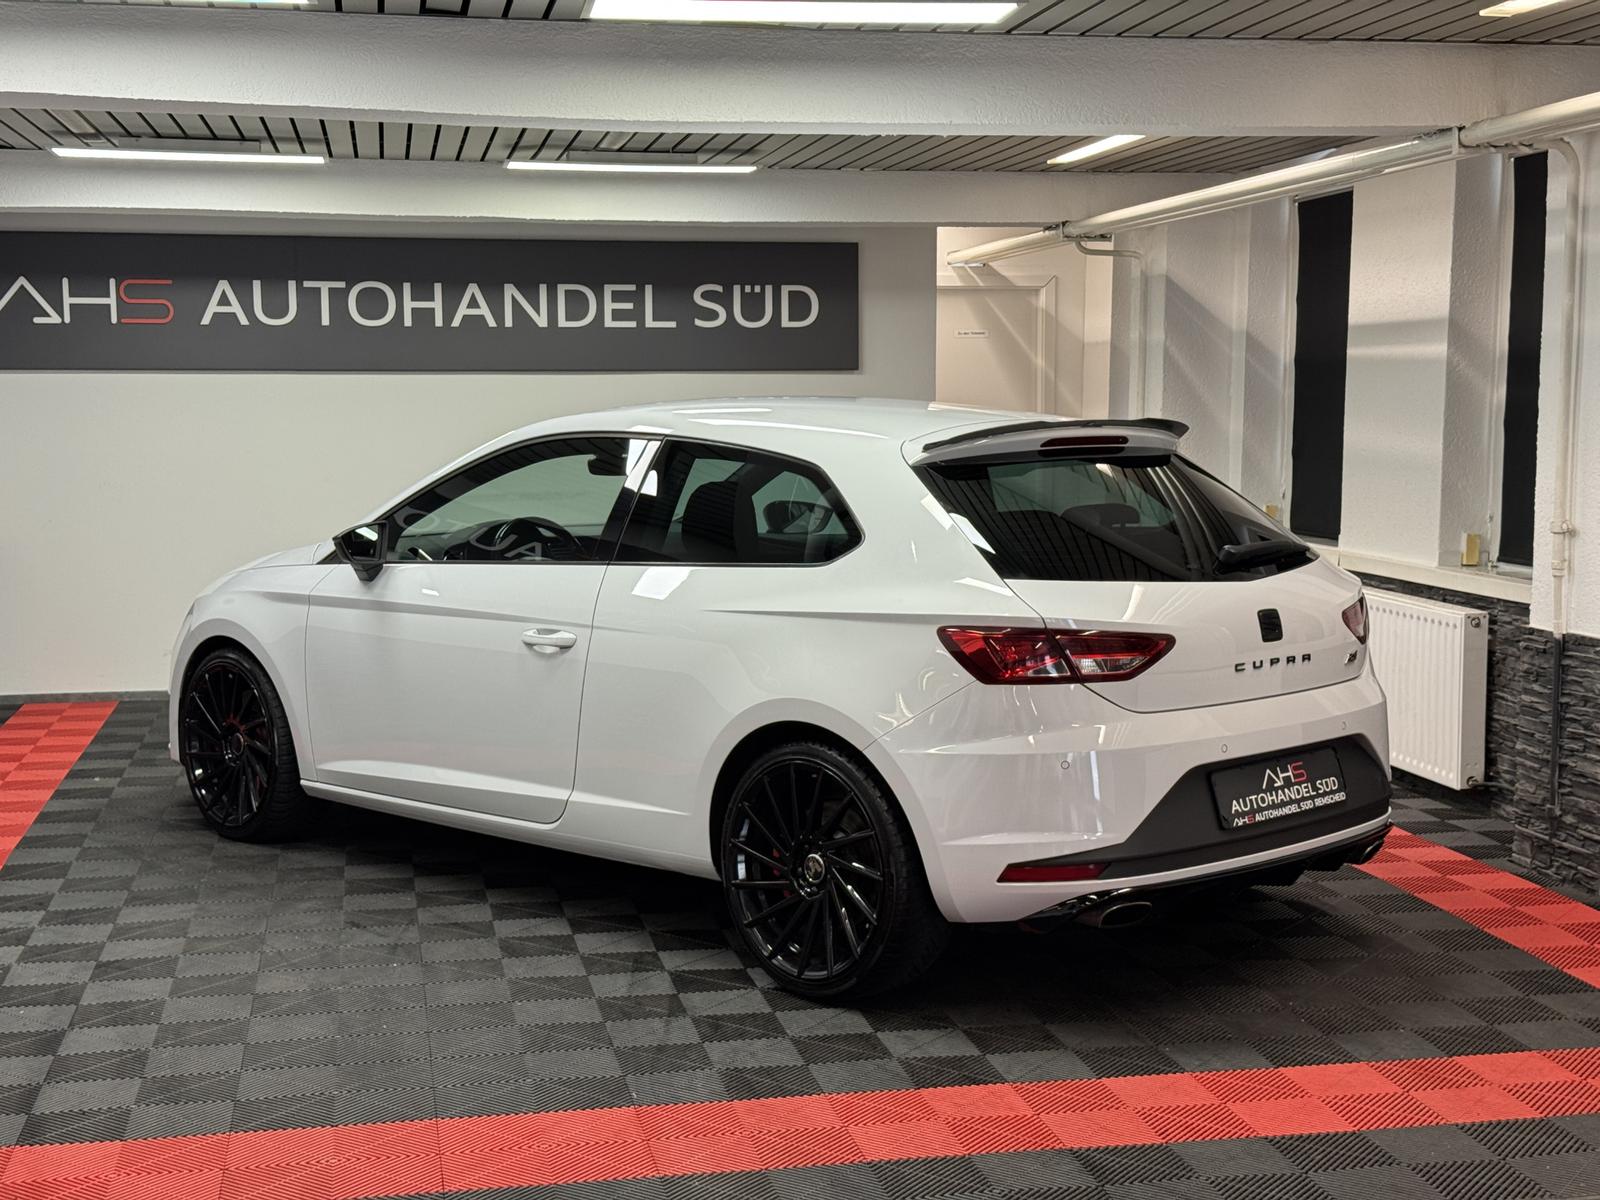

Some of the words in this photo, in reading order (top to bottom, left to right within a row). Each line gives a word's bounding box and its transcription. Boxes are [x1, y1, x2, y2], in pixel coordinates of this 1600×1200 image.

[0, 275, 174, 325] AHS
[200, 279, 677, 328] AUTOHANDEL
[692, 283, 820, 328] SÜD
[1234, 653, 1311, 673] CUPRA
[1262, 761, 1308, 789] AHS
[1231, 783, 1314, 814] AUTOHANDEL
[1317, 776, 1338, 793] SÜD
[1255, 804, 1301, 822] AUTOHANDEL
[1314, 792, 1346, 805] REMSCHEID
